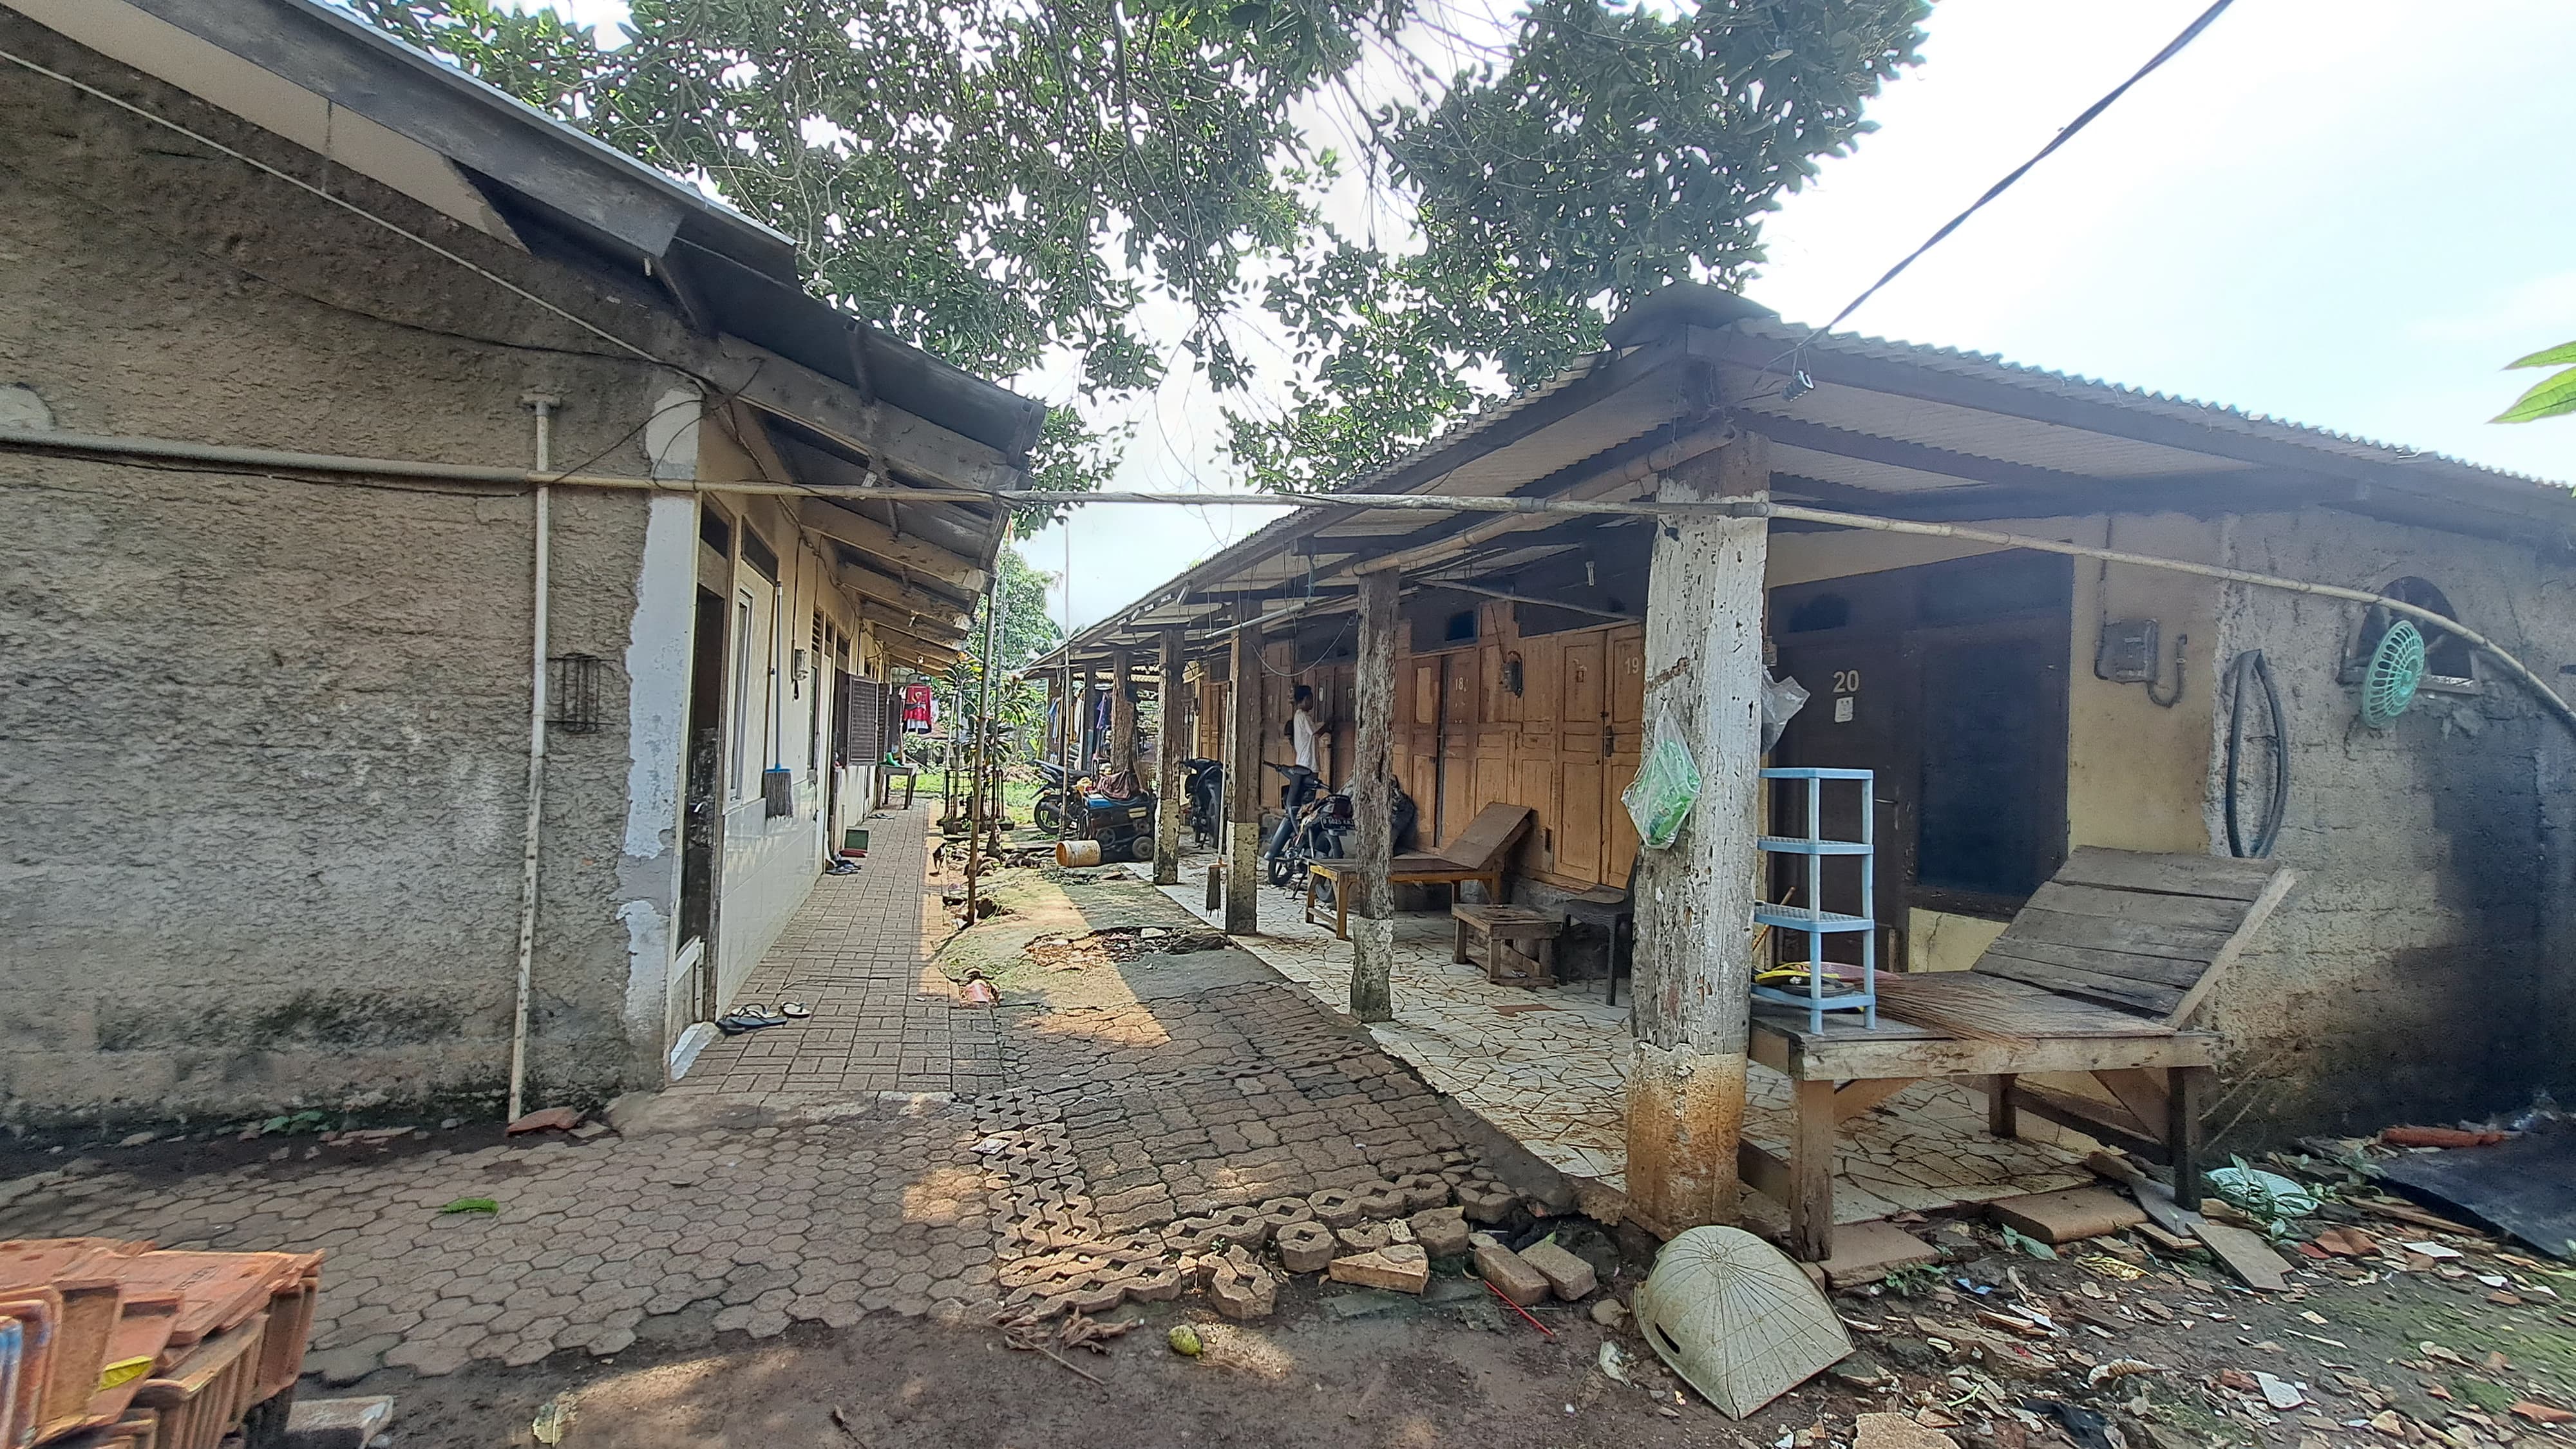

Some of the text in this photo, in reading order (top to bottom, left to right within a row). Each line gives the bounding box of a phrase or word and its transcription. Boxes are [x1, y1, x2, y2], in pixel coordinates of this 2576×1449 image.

[1625, 657, 1639, 675] 19
[1455, 677, 1464, 690] 18
[1833, 670, 1859, 693] 20
